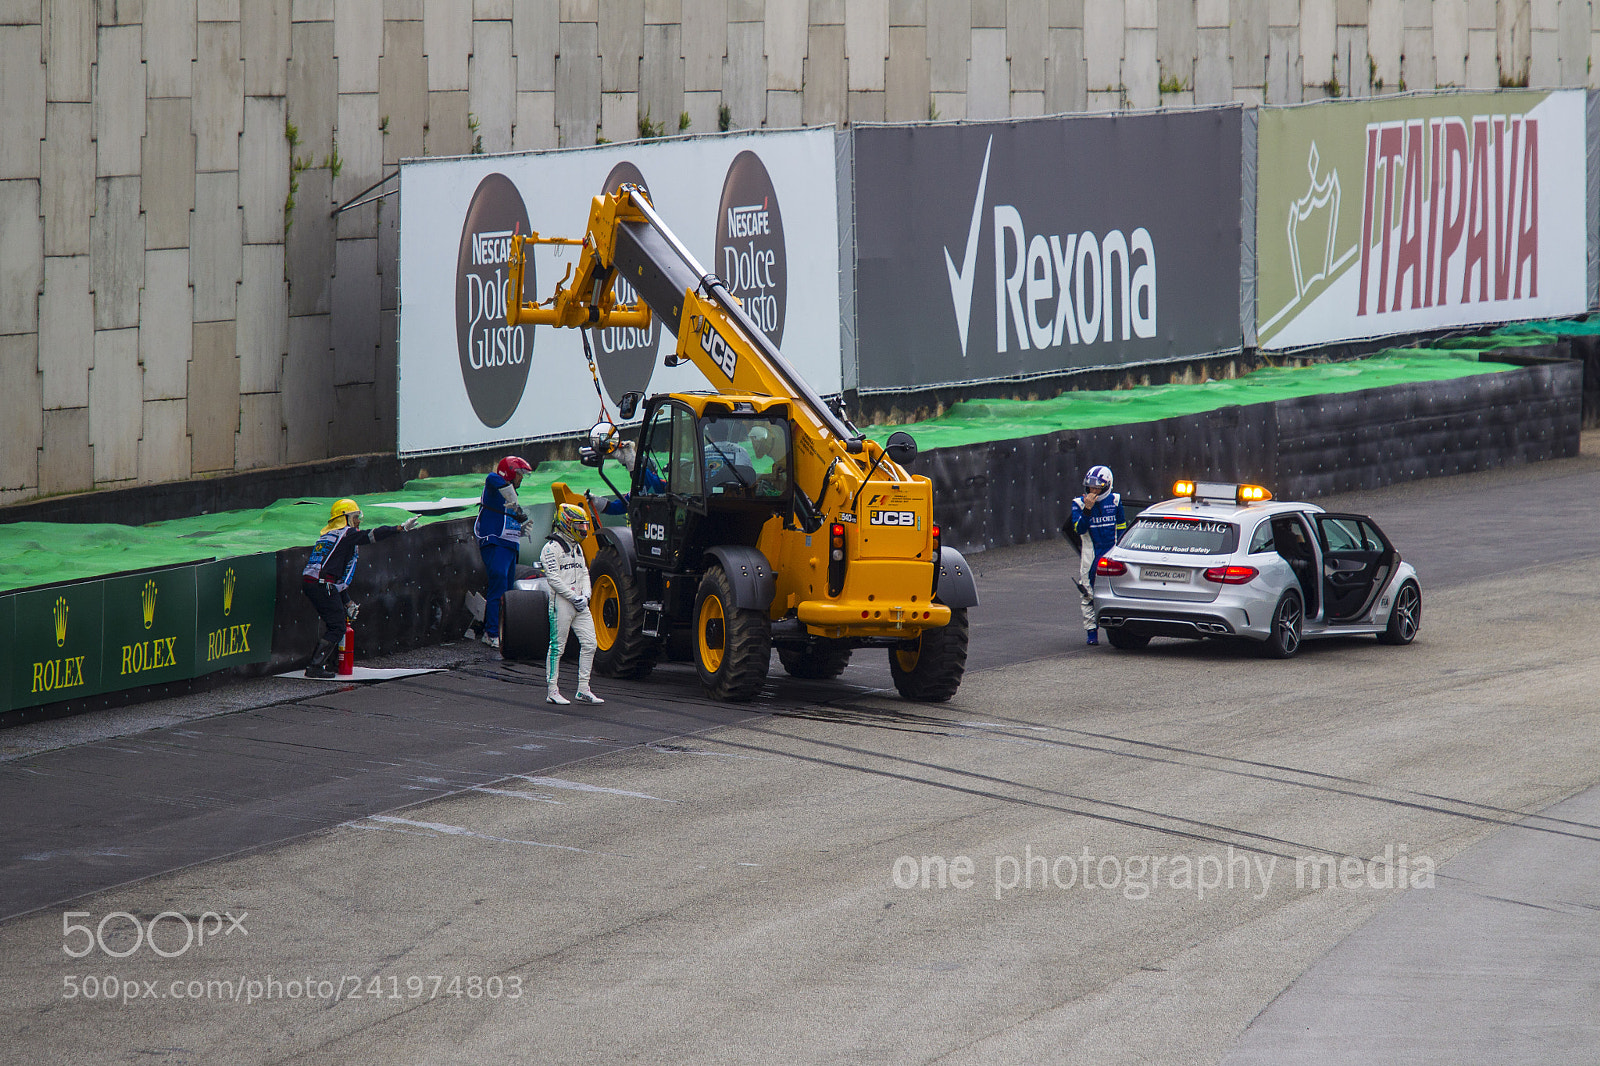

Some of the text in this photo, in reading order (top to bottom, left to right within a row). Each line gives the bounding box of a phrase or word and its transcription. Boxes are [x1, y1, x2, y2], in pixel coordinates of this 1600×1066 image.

[1357, 115, 1538, 317] ITAIPAVA
[472, 230, 512, 266] NESCAF
[723, 240, 776, 295] Dolce
[466, 268, 524, 324] Dolc
[994, 204, 1157, 353] Rexona
[468, 324, 525, 370] Gusto
[701, 326, 736, 379] JCB
[644, 523, 665, 541] JCB
[870, 511, 915, 526] JCB
[1135, 519, 1228, 534] Mercedes-AMG
[1141, 543, 1160, 551] Action
[1189, 546, 1211, 555] Safety
[1144, 570, 1171, 579] MEDICAL
[120, 636, 177, 676] ROLEX
[207, 623, 251, 662] ROLEX
[31, 655, 85, 693] ROLEX
